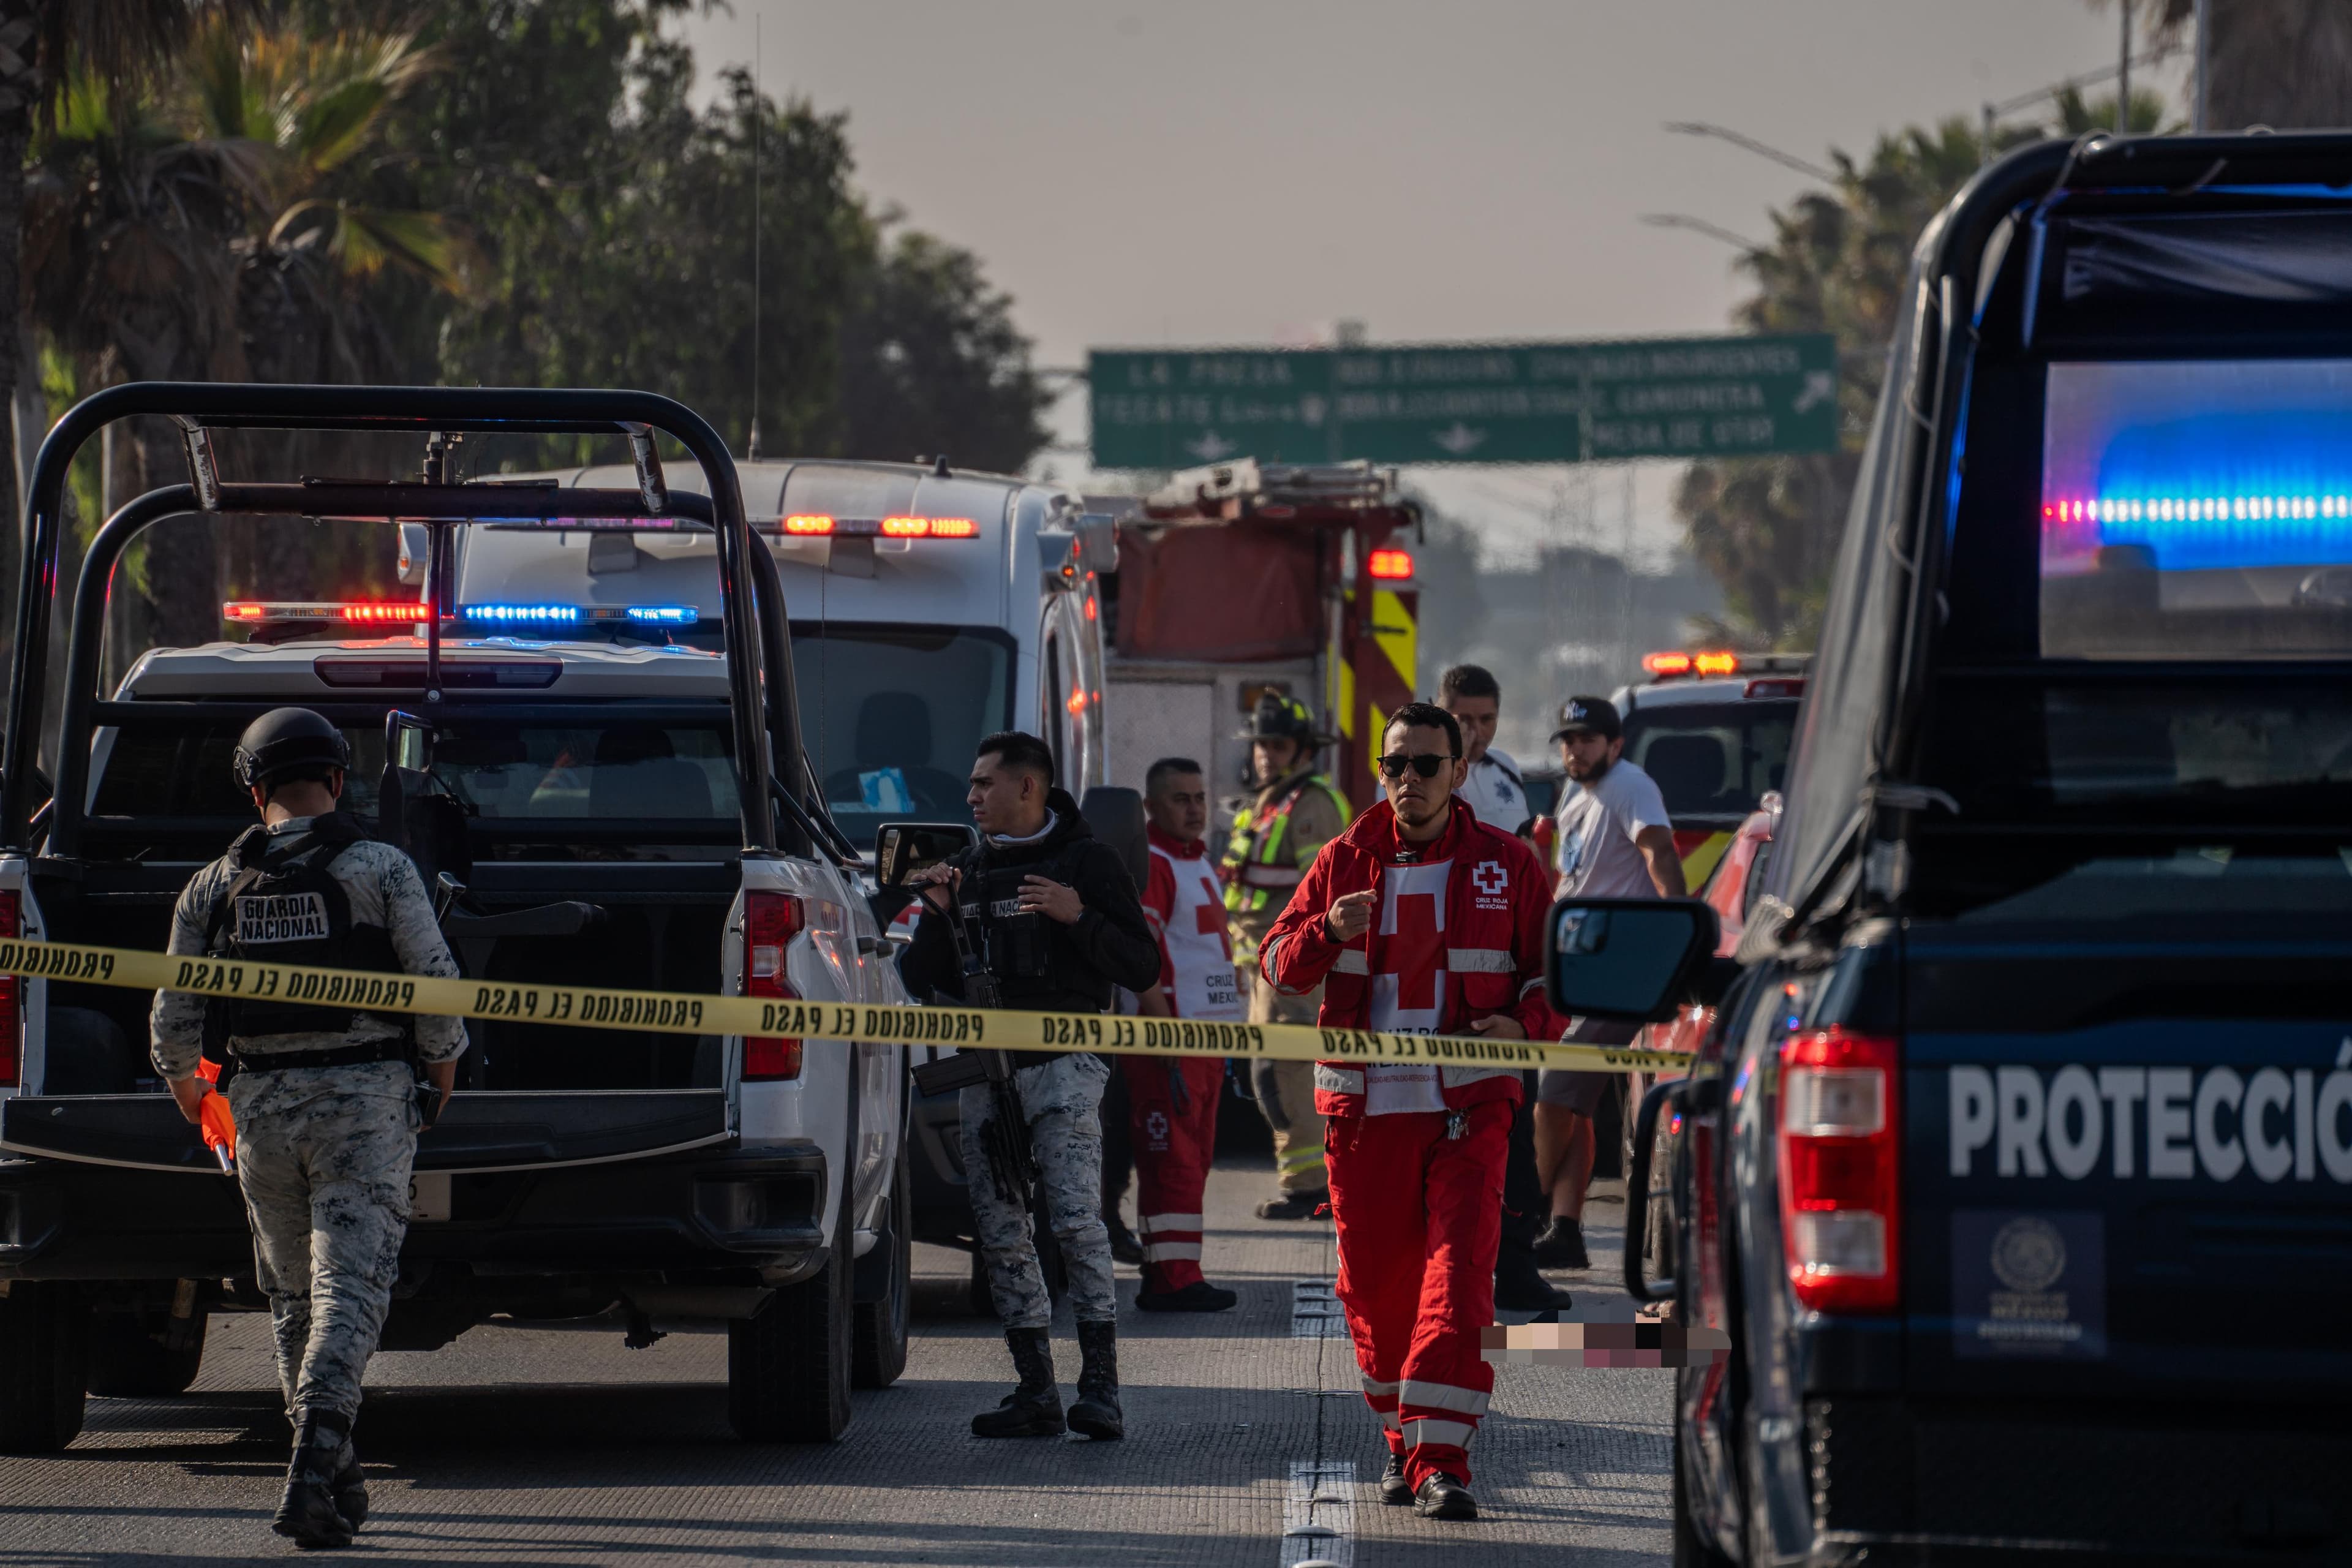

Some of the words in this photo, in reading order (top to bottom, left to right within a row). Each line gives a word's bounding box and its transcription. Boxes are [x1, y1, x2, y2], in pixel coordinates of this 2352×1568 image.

[245, 895, 318, 919] GUARDIA
[242, 916, 325, 940] NACIONAL
[1206, 975, 1234, 987] CRUZ
